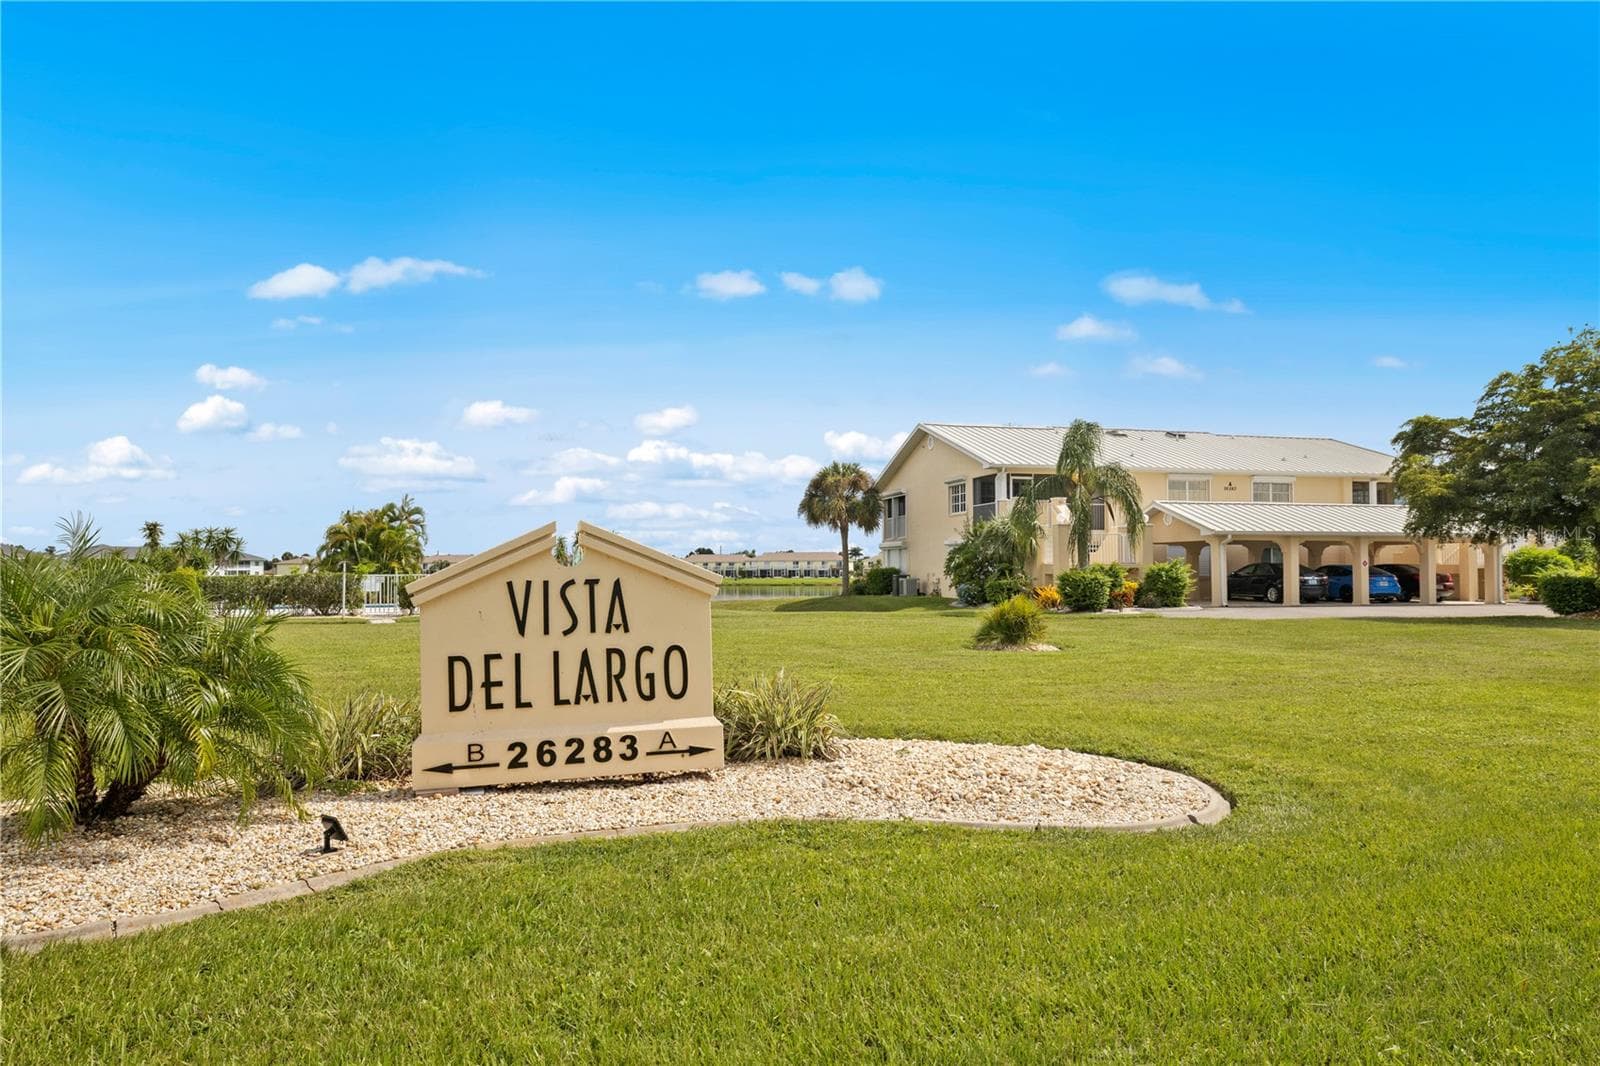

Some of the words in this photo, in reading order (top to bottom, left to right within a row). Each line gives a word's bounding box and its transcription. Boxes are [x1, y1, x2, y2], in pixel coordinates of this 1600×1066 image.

[505, 577, 630, 637] VISTA
[447, 653, 534, 713] DEL
[552, 644, 689, 706] LARGO
[467, 743, 485, 763] B
[507, 734, 639, 770] 26283
[658, 731, 677, 750] A
